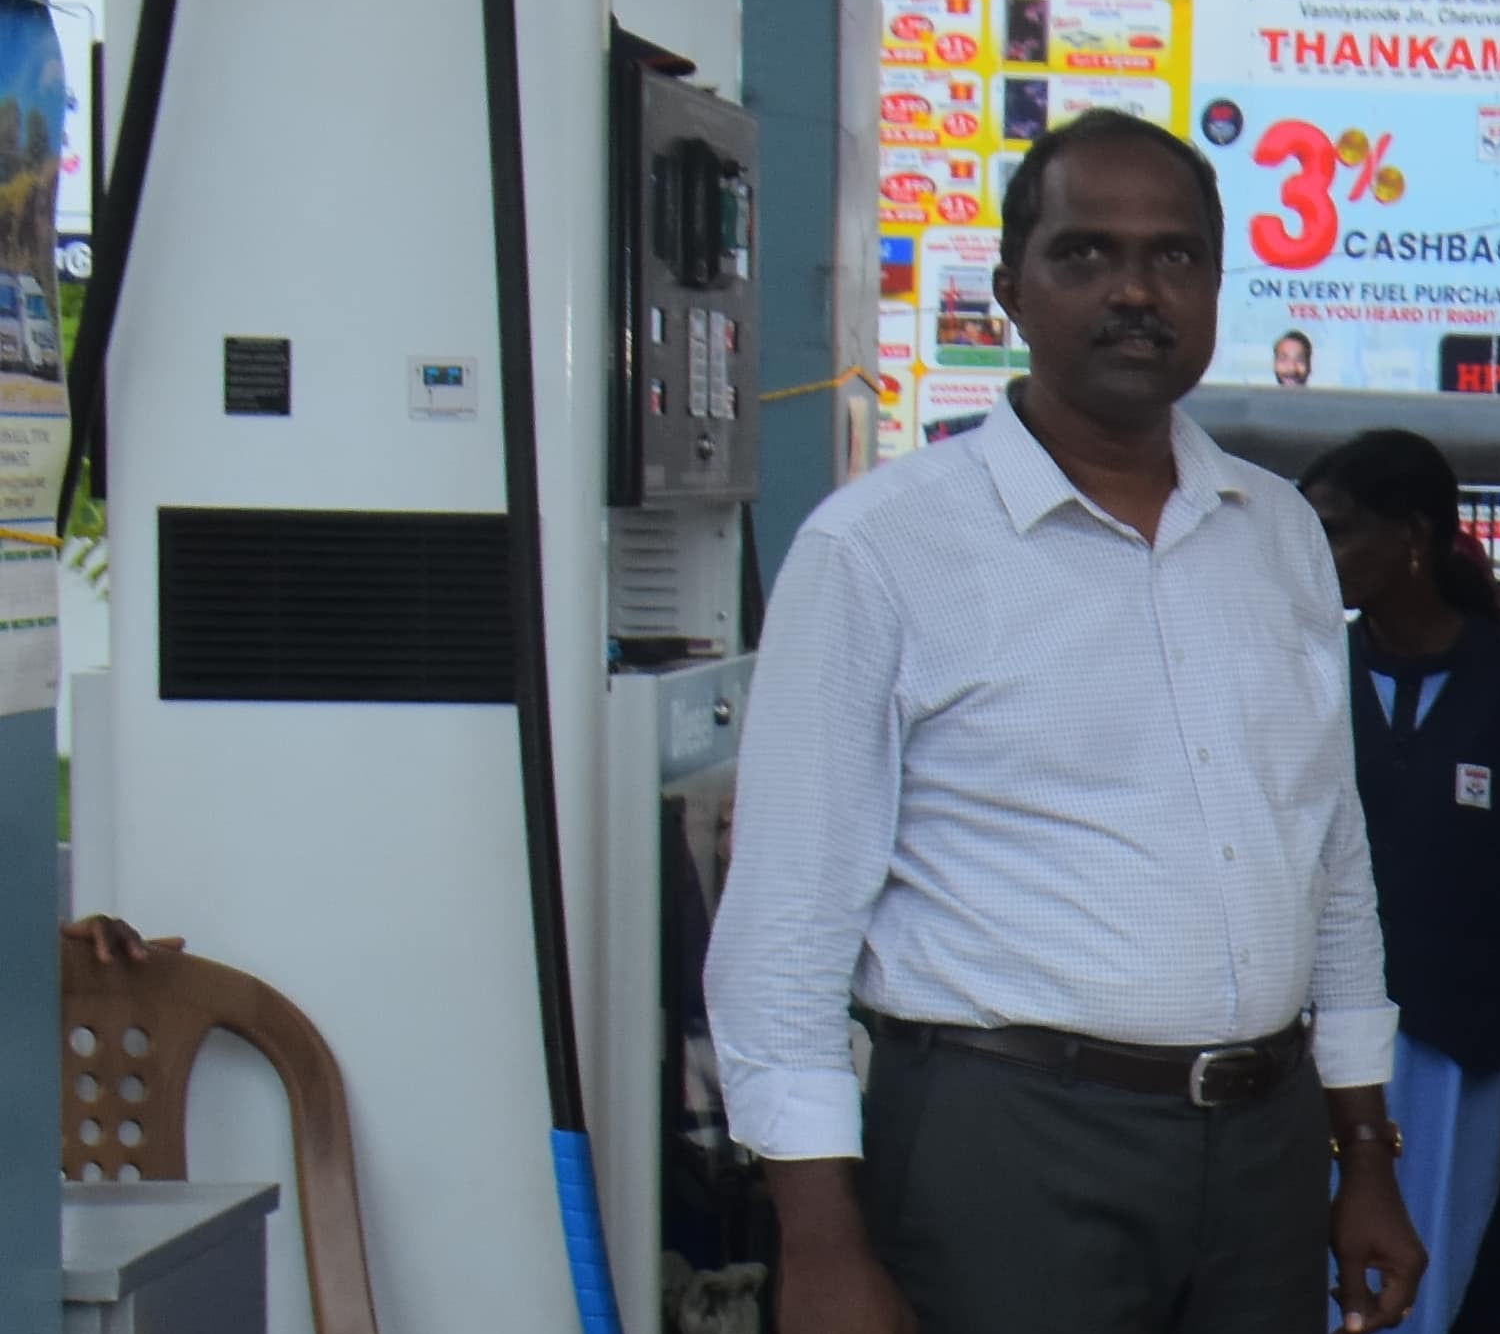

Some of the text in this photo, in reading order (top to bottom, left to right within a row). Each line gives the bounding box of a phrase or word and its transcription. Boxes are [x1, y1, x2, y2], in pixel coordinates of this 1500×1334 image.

[1249, 279, 1281, 299] ON
[1287, 280, 1355, 302] EVERY
[1360, 283, 1408, 303] FUEL
[1288, 304, 1323, 321] YES,
[1325, 305, 1361, 322] YOU
[1365, 306, 1424, 323] HEARD
[1427, 307, 1441, 323] IT
